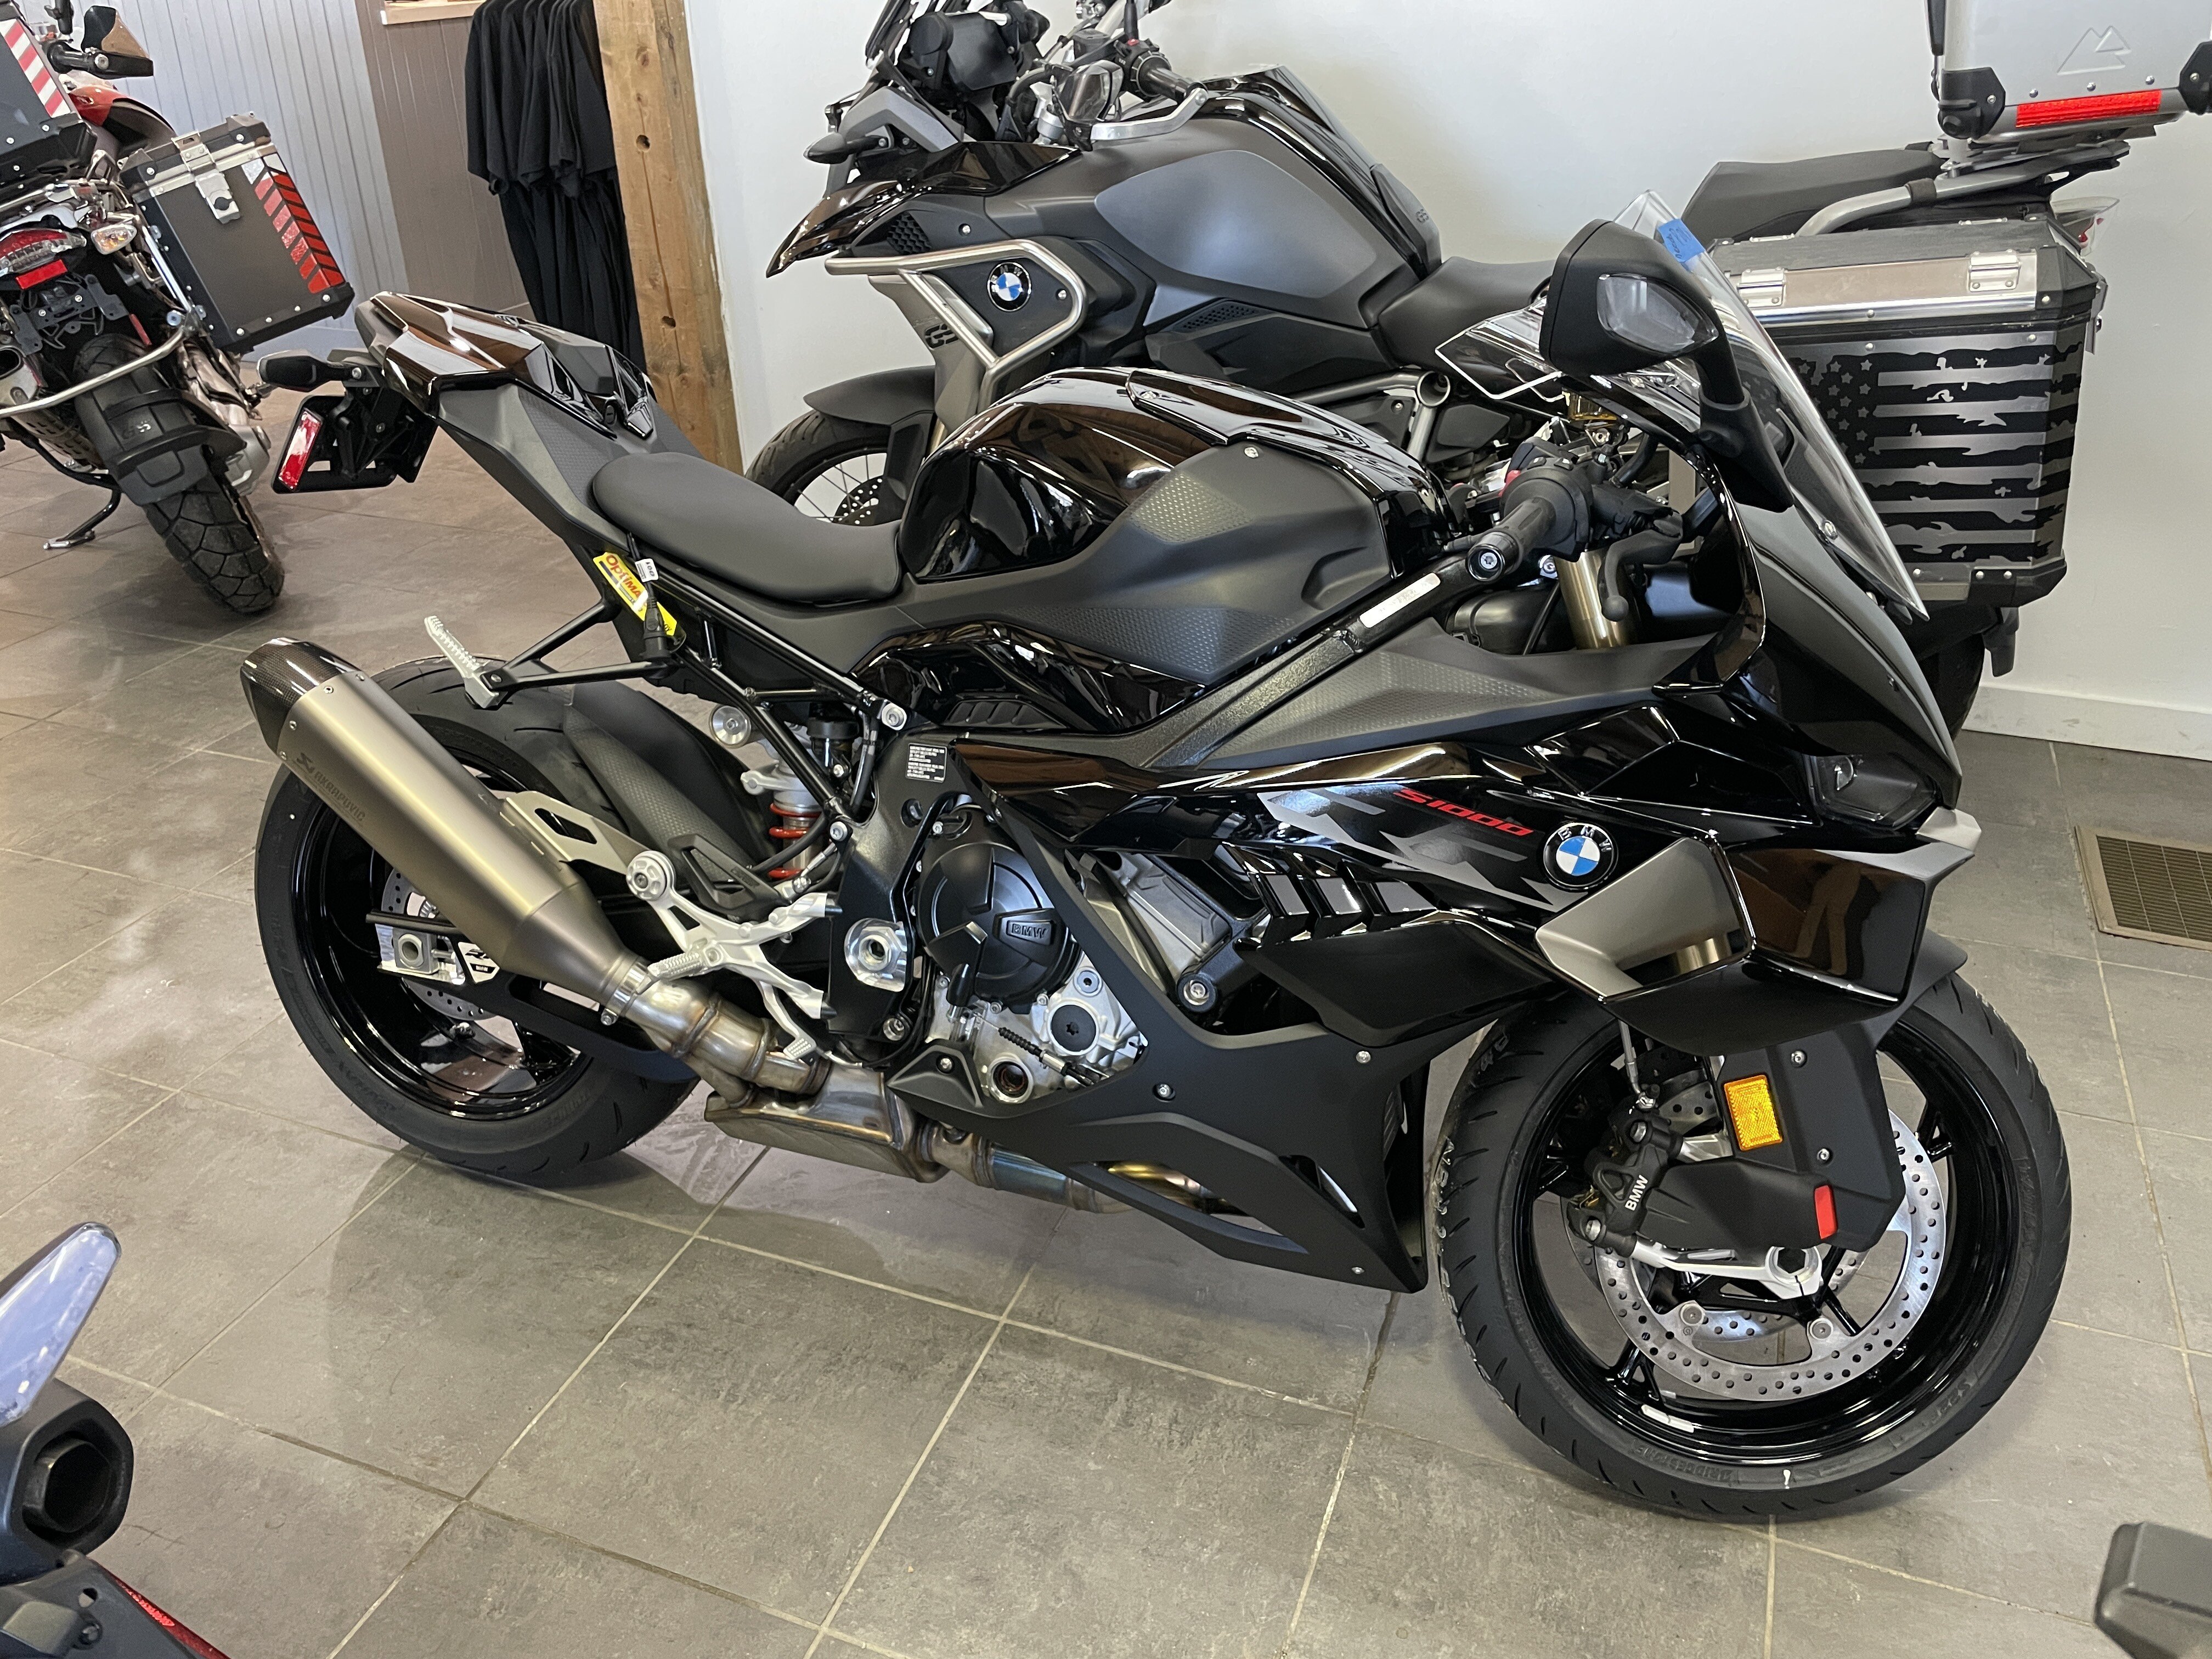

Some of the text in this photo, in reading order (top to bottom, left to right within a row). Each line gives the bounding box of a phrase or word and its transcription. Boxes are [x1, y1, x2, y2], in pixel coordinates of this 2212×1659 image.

[990, 264, 1023, 284] BMW
[606, 555, 648, 609] OptiMA
[1393, 788, 1534, 836] S1000
[1558, 825, 1612, 853] BMW
[1011, 923, 1047, 939] BMW
[1624, 1175, 1648, 1211] BMW
